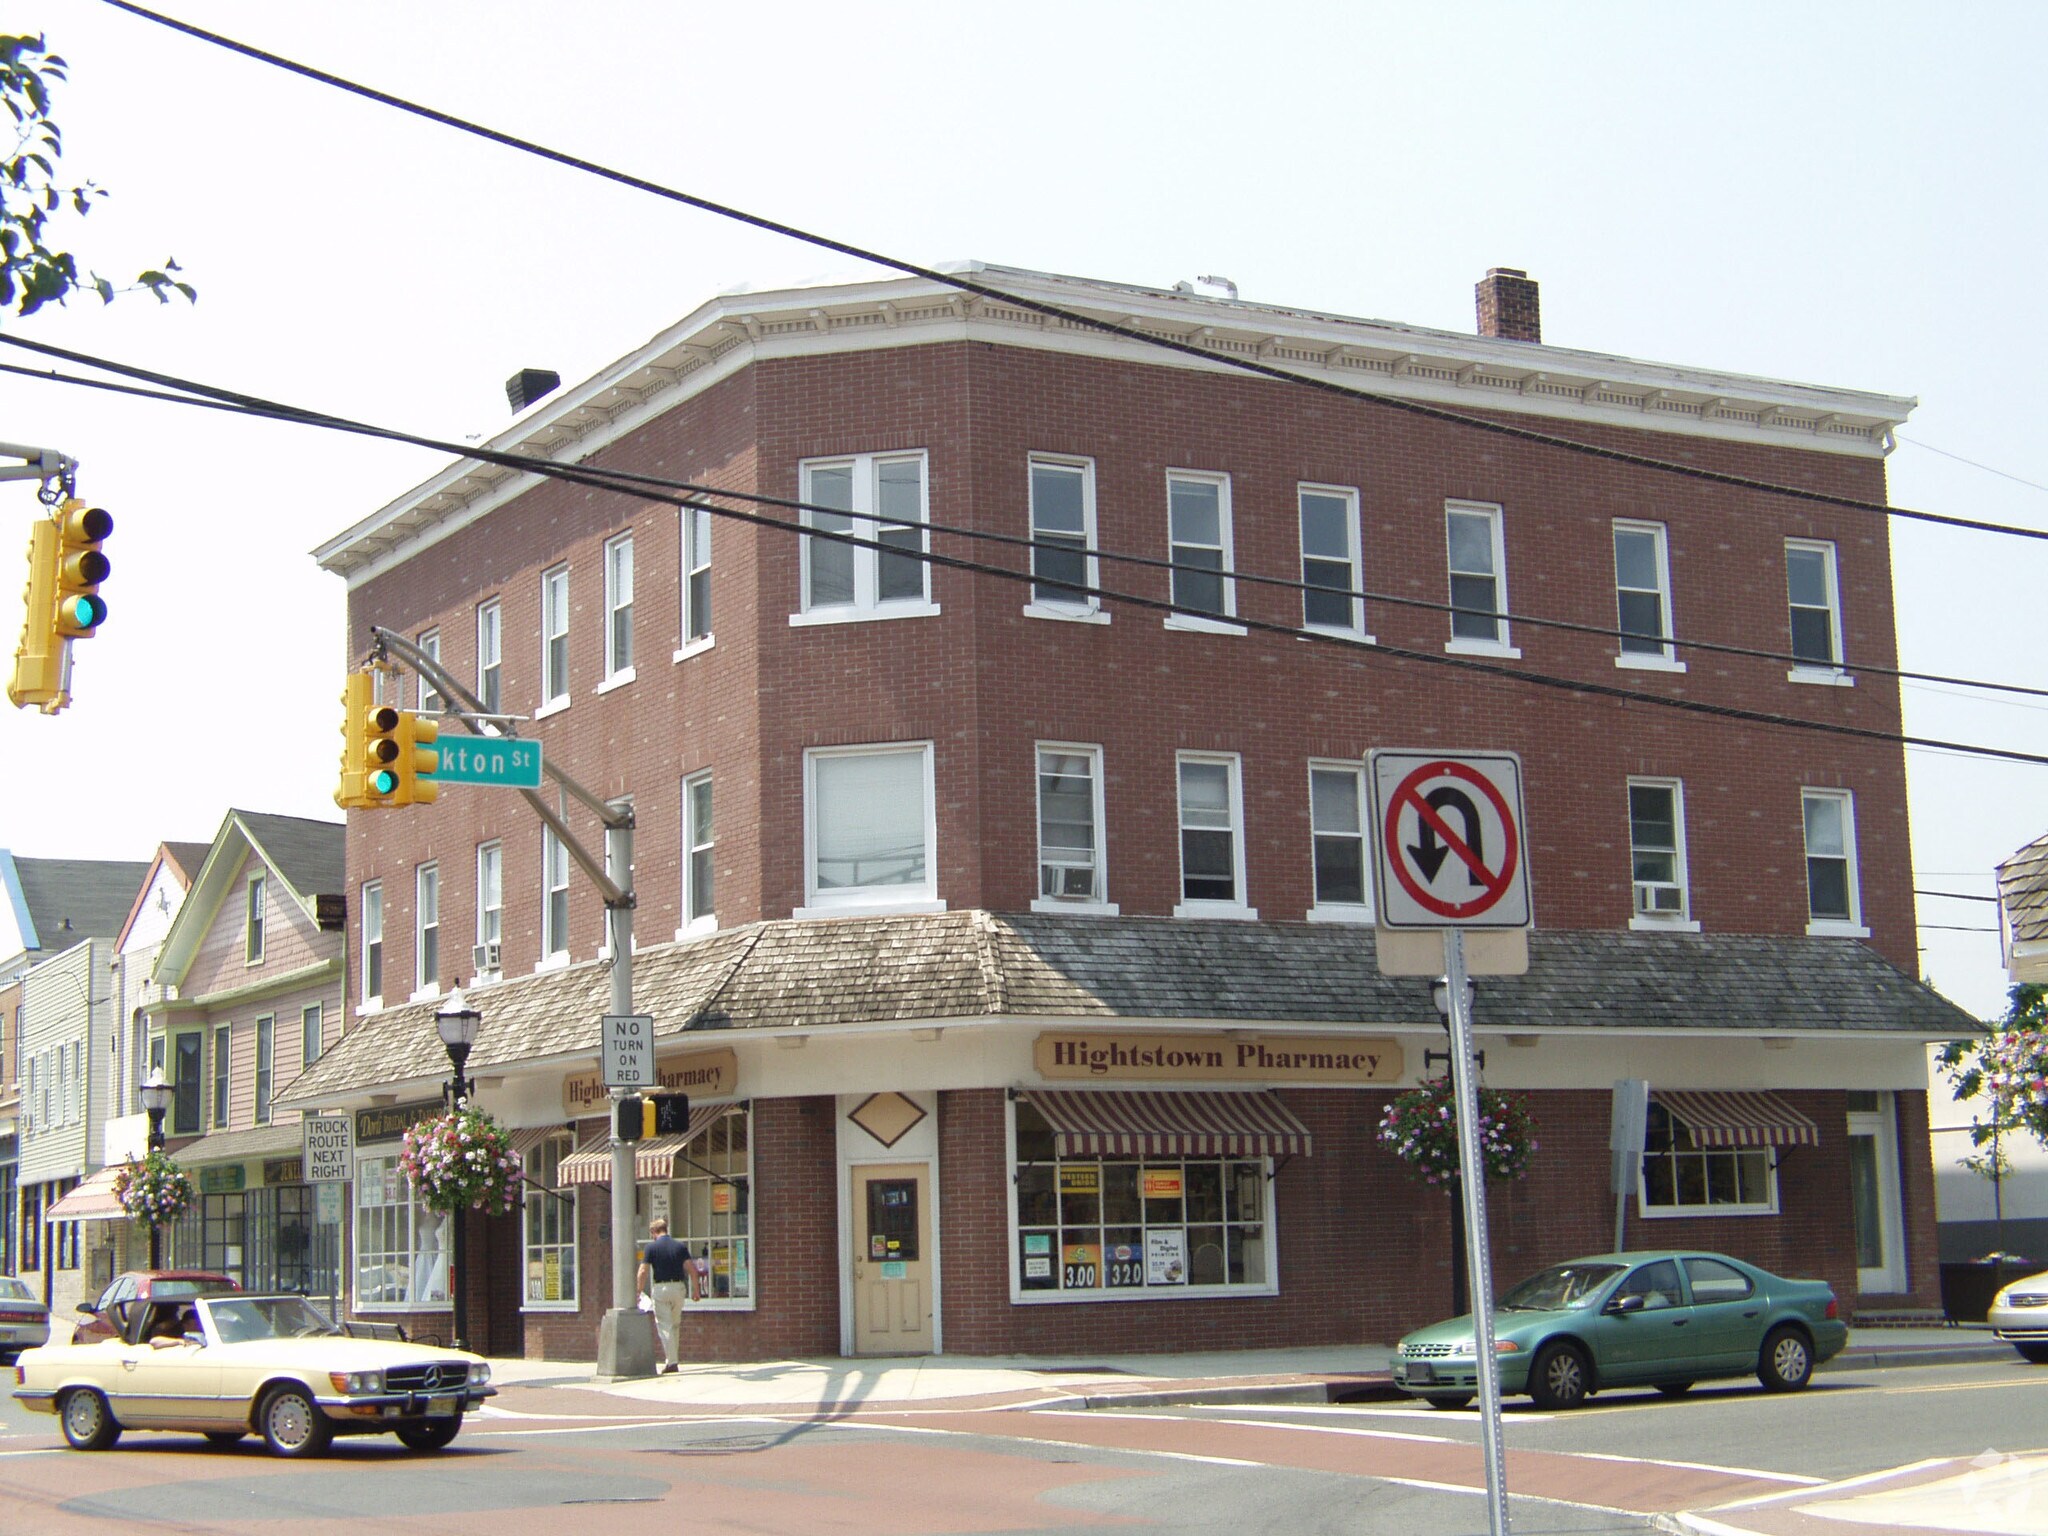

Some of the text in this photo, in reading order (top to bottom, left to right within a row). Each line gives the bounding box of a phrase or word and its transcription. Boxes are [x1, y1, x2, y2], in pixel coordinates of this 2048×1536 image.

[442, 746, 530, 774] kton St
[616, 1022, 640, 1036] NO
[613, 1040, 643, 1051] TURN
[619, 1055, 637, 1066] ON
[1053, 1041, 1382, 1078] Hightstown Pharmacy
[617, 1070, 640, 1081] RED
[569, 1065, 723, 1109] Hight harmacy
[308, 1121, 349, 1134] TRUCK
[308, 1135, 349, 1149] ROUTE
[313, 1150, 344, 1163] NEXT
[311, 1165, 347, 1178] RIGHT
[1066, 1265, 1095, 1287] 3.00
